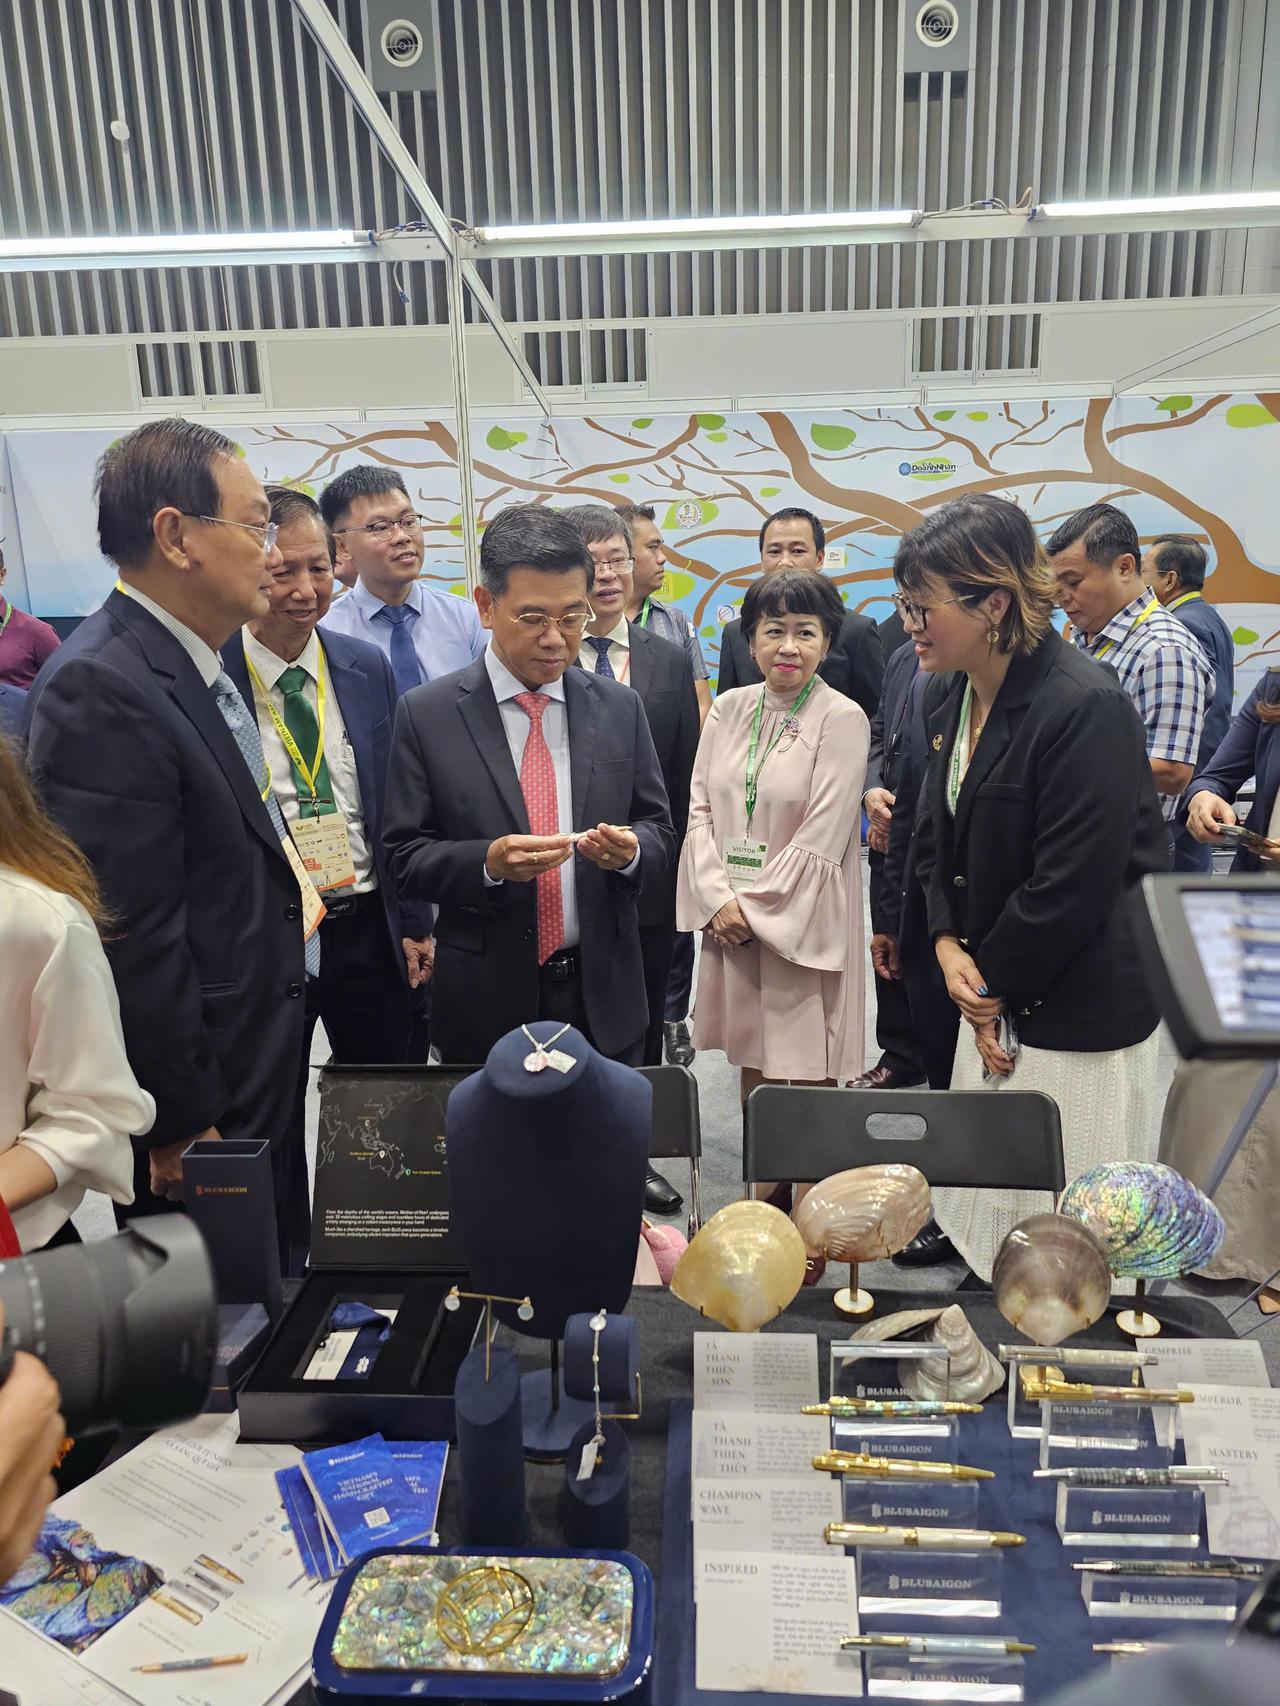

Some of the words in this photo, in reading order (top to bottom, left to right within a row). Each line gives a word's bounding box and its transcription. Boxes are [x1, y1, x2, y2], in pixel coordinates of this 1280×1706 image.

[732, 846, 756, 854] VISITOR
[705, 1353, 740, 1362] THANH
[1197, 1395, 1243, 1406] MPEROR
[713, 1436, 751, 1447] THANH
[871, 1445, 932, 1454] BLUSAIGON
[1208, 1447, 1259, 1460] MASTERY
[699, 1489, 762, 1501] CHAMPION
[700, 1505, 731, 1515] WAVE
[883, 1506, 949, 1517] BLUSAIGON
[1104, 1513, 1171, 1523] BLUSAIGON
[704, 1562, 758, 1576] INSPIRED
[901, 1577, 972, 1589] BLUSAIGON
[1132, 1594, 1204, 1605] BLUSAIGON
[914, 1673, 990, 1684] BLUSAIGON
